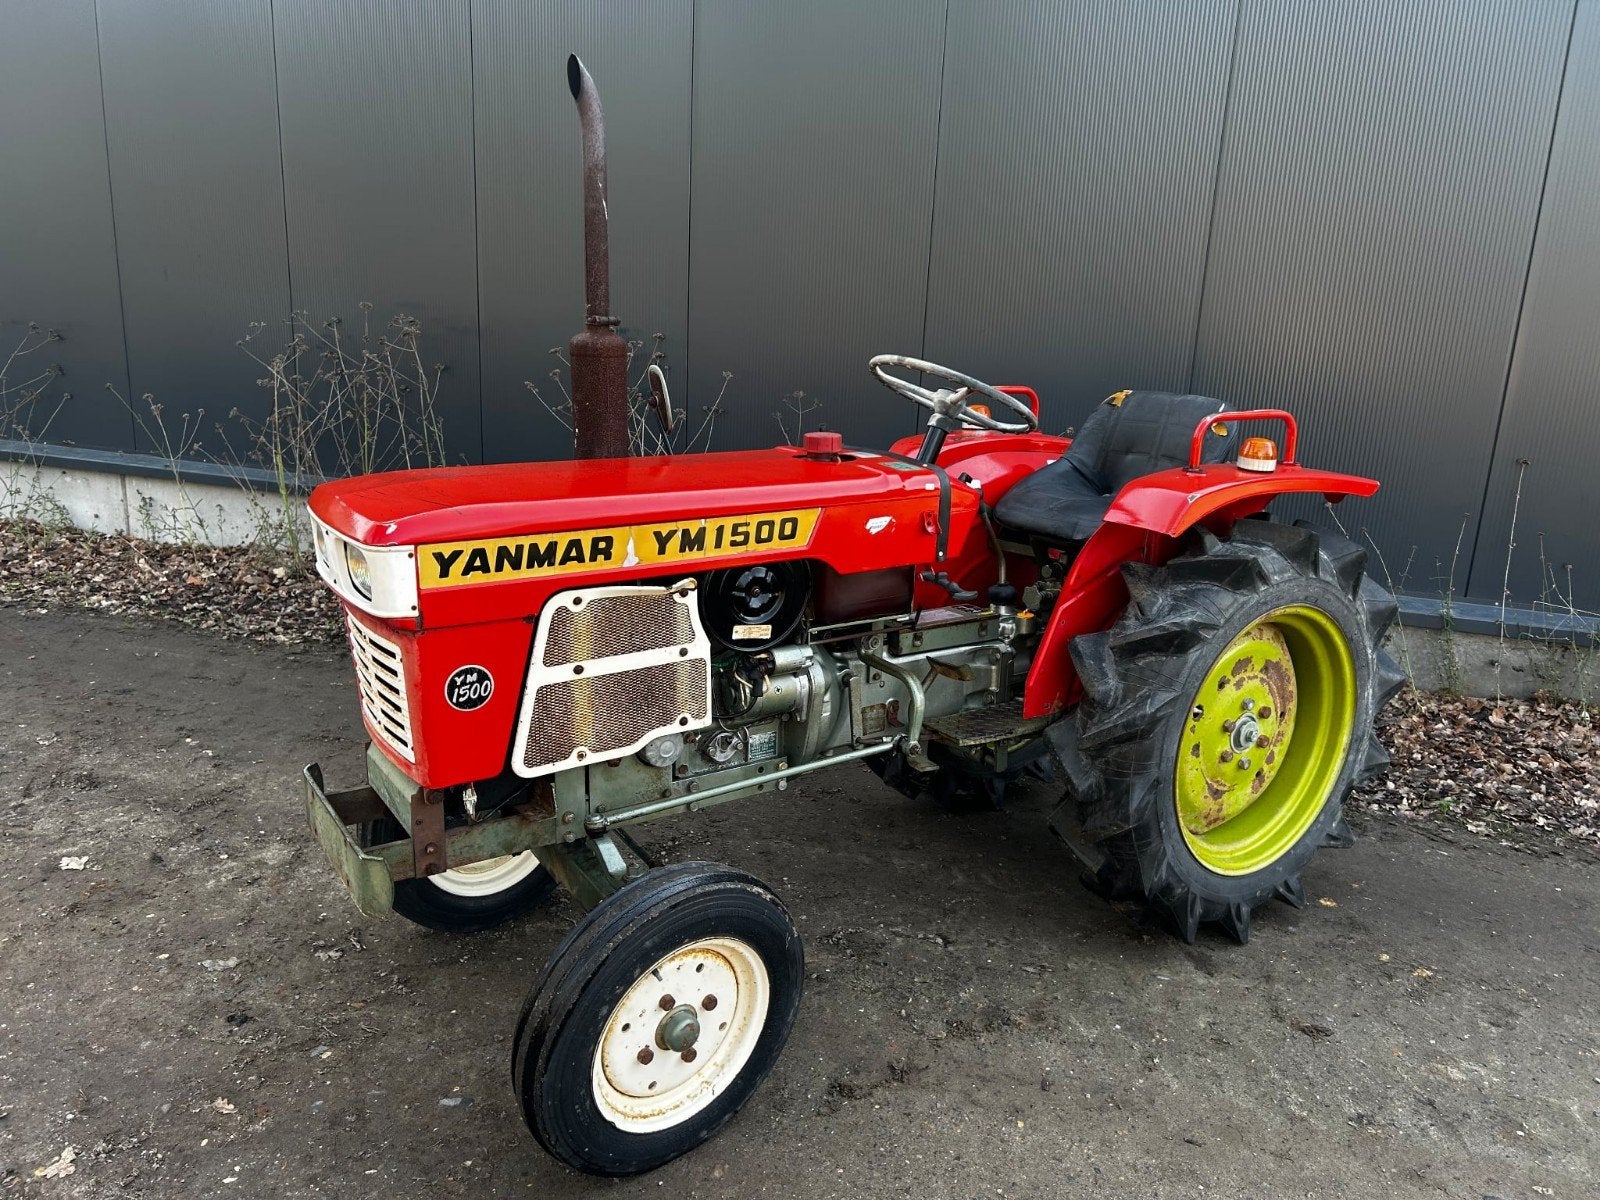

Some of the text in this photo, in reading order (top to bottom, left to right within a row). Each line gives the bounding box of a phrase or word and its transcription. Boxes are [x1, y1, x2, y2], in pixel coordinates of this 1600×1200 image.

[432, 536, 614, 578] YANMAR
[454, 673, 477, 685] YM
[452, 680, 490, 703] 1500
